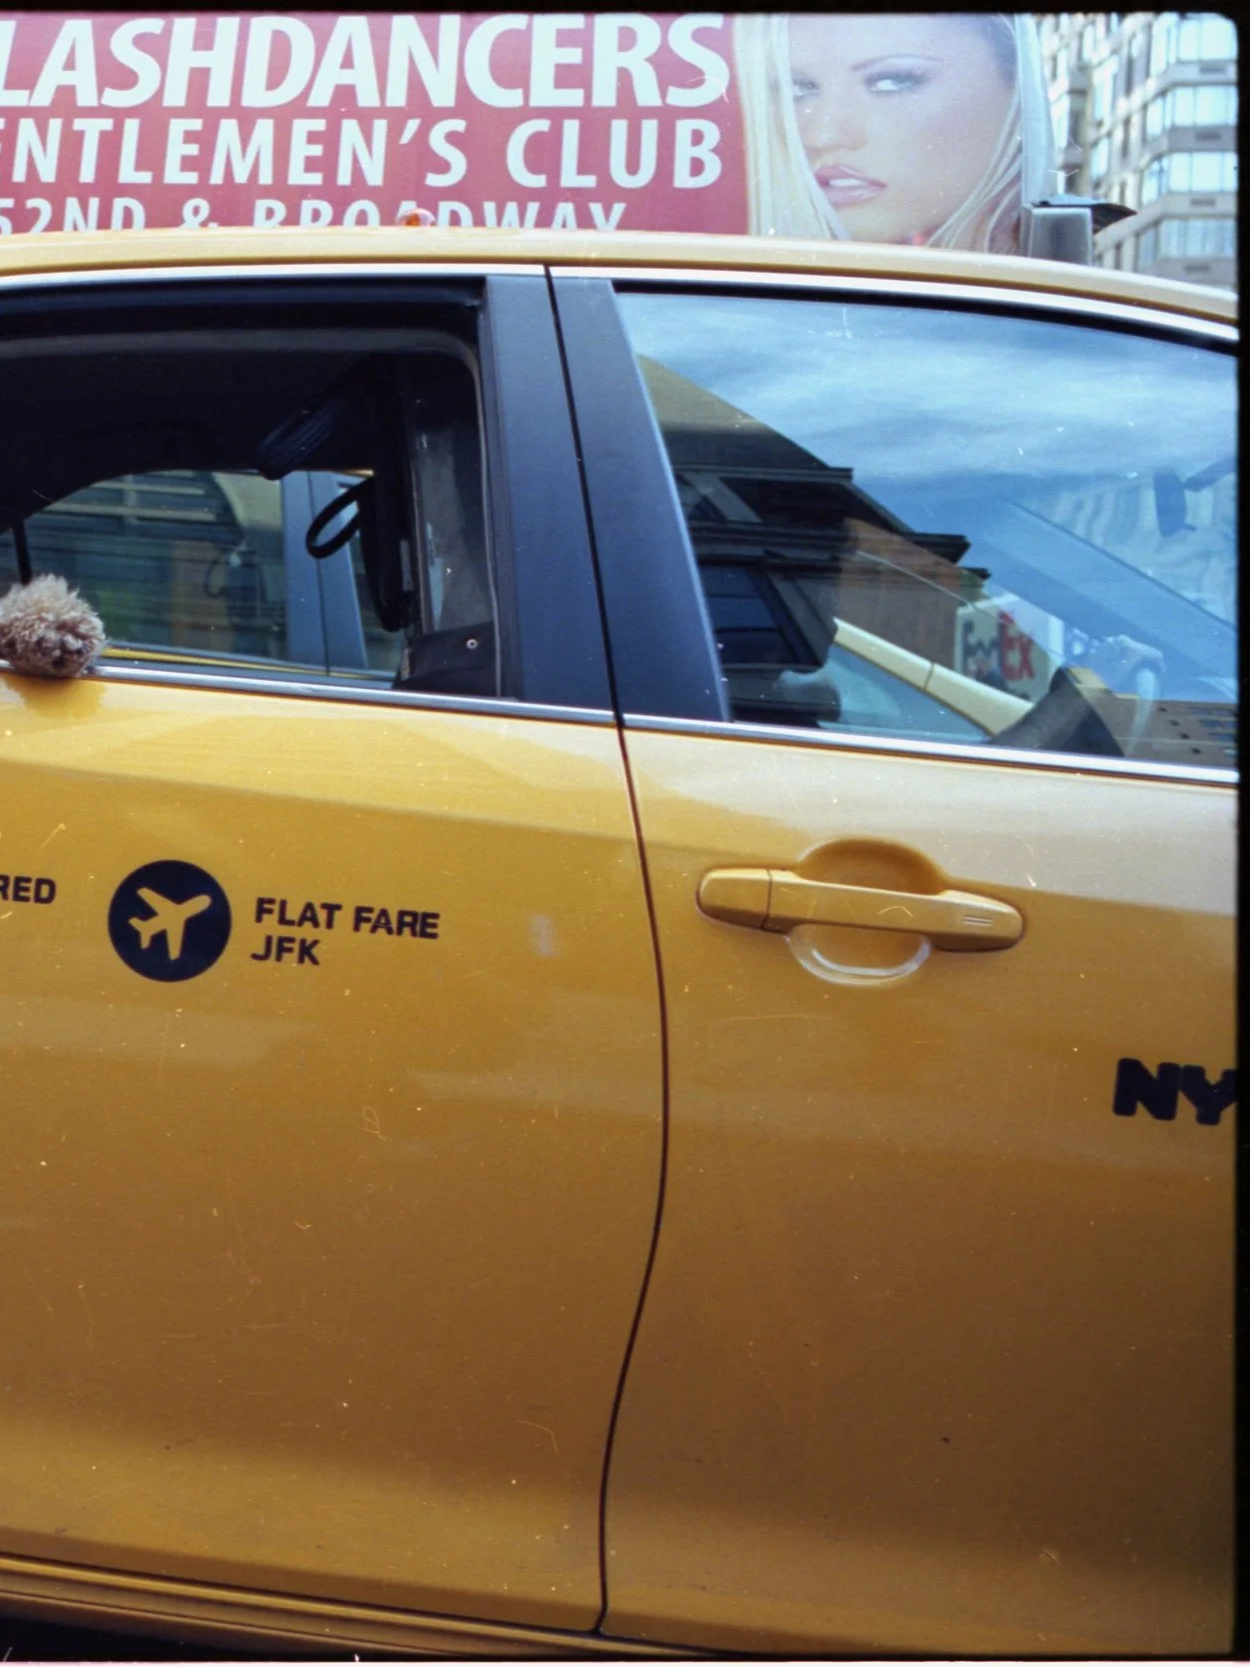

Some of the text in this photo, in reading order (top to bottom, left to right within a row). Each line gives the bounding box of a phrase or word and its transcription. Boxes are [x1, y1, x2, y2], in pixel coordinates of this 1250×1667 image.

[506, 119, 722, 189] CLUB
[178, 198, 219, 229] &
[253, 198, 627, 232] BRODWAY
[255, 897, 441, 940] FLAT FARE
[250, 935, 321, 966] JFK
[1113, 1058, 1236, 1126] NY
